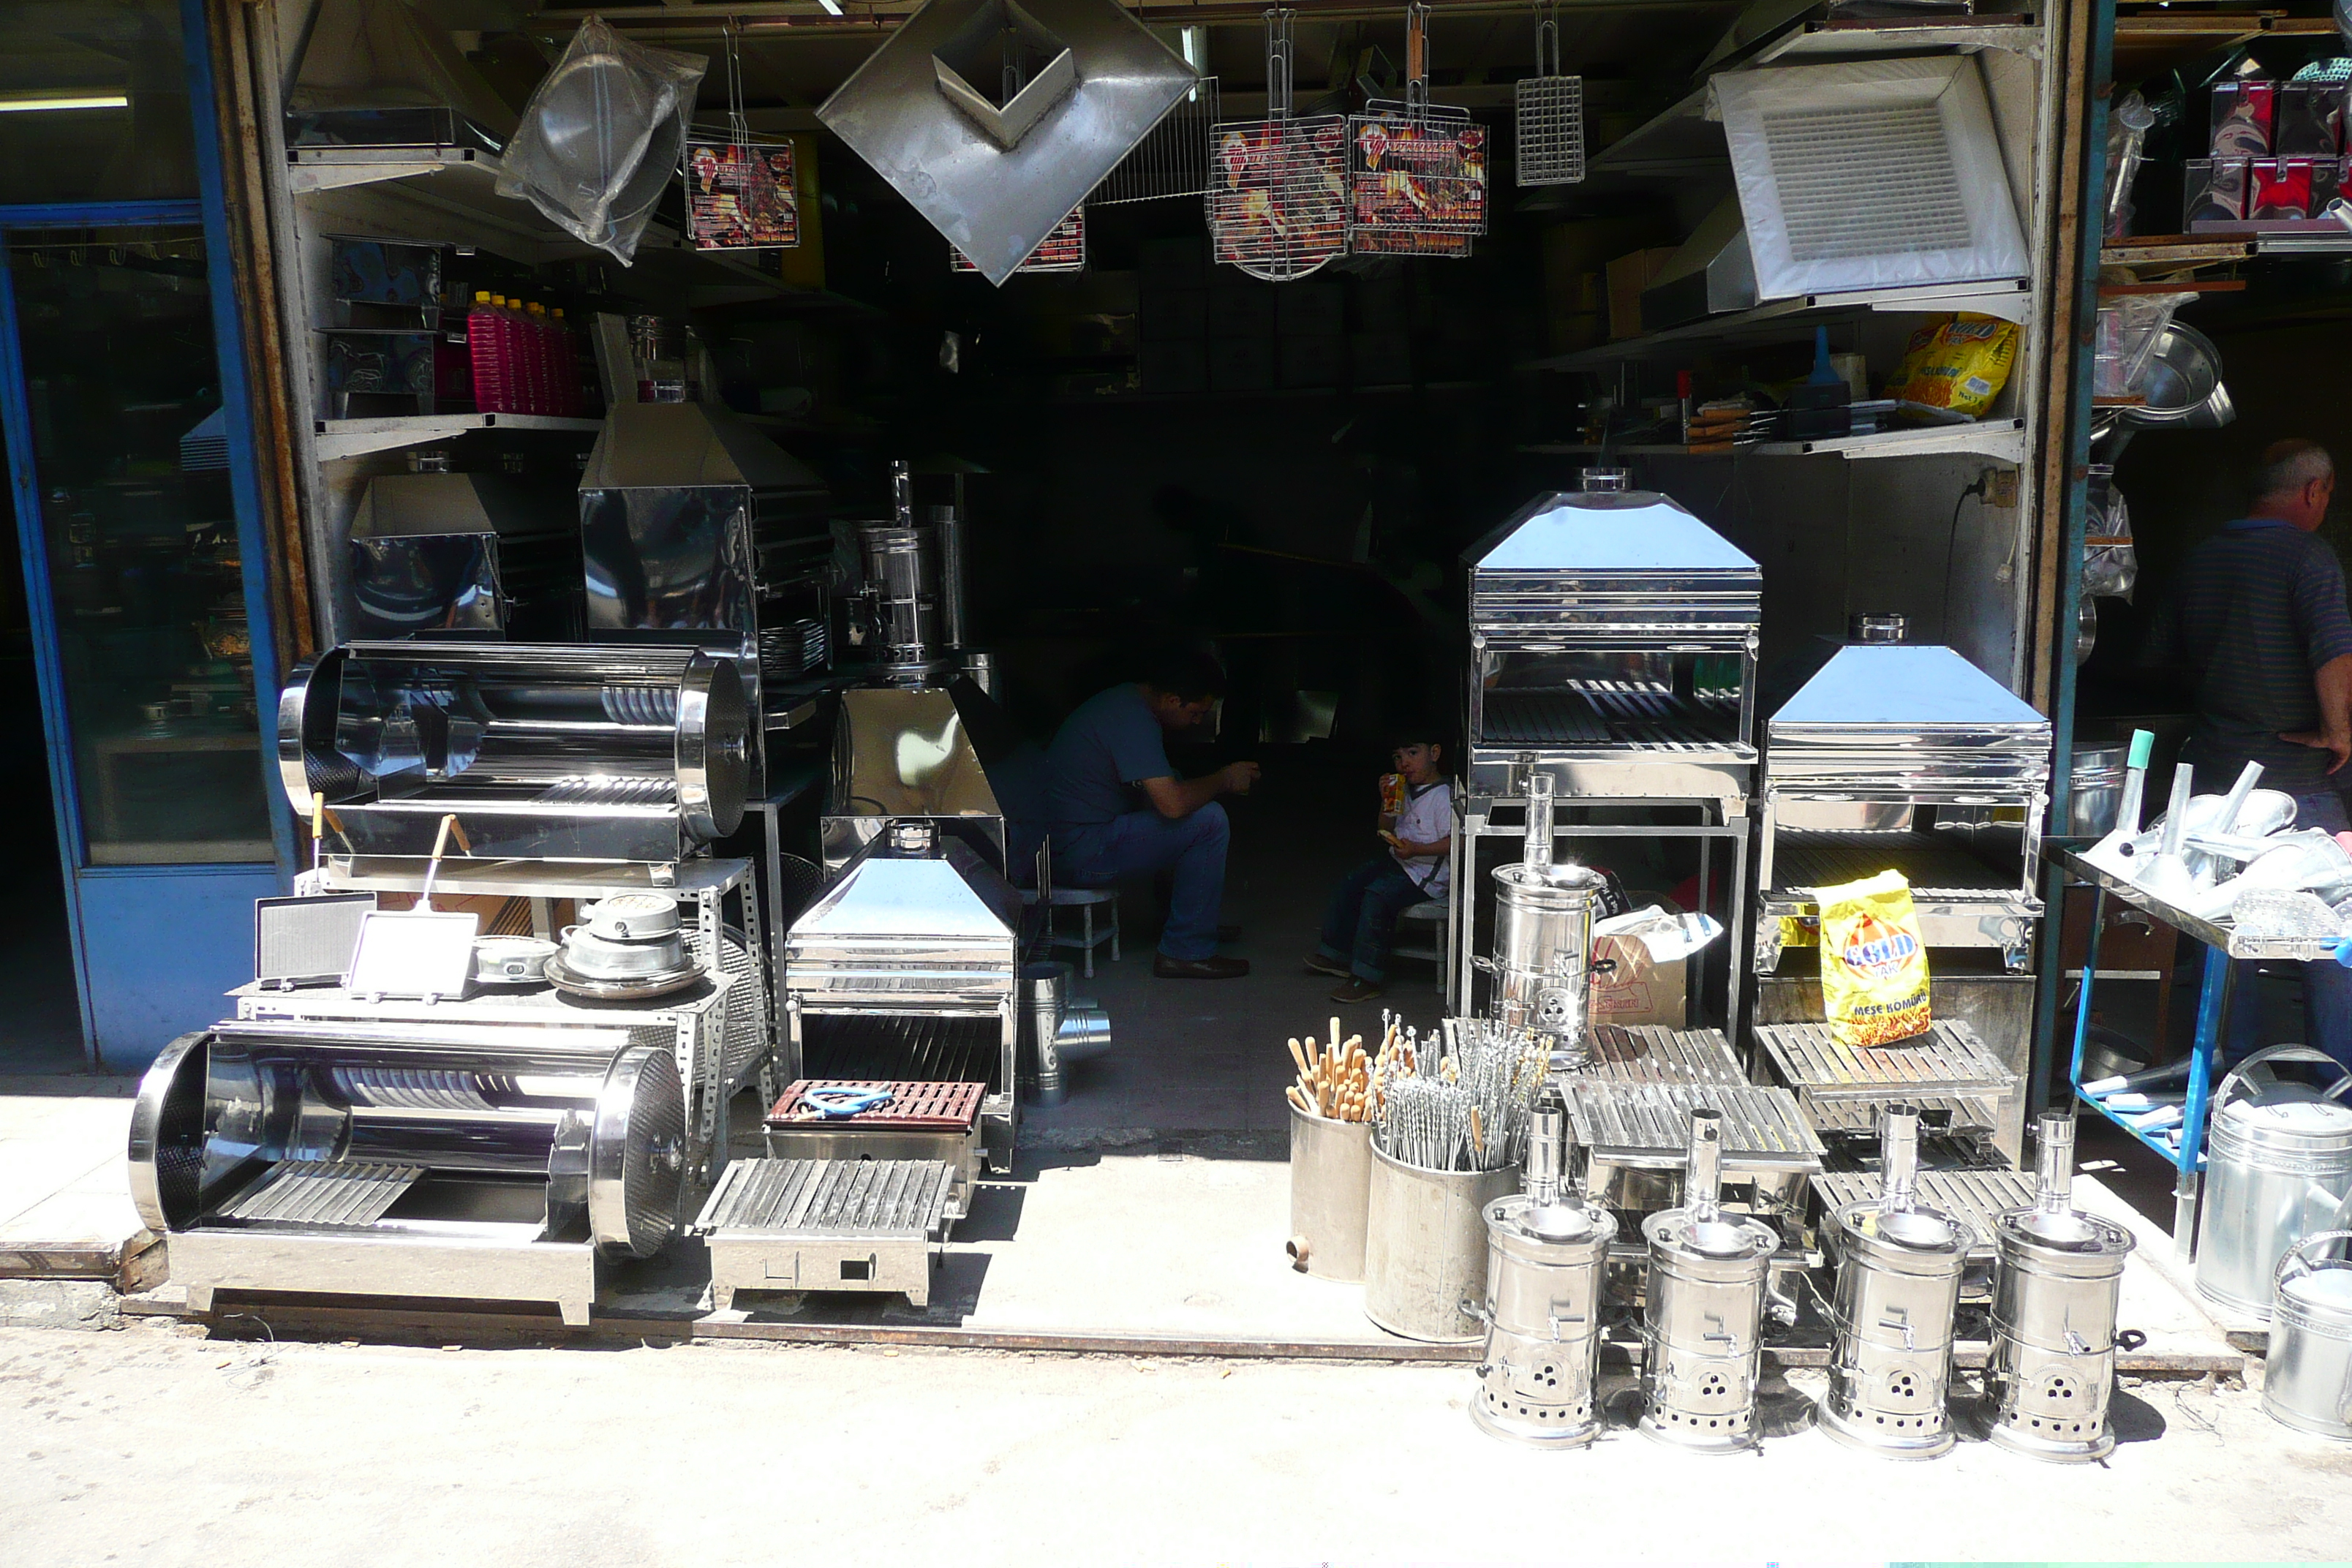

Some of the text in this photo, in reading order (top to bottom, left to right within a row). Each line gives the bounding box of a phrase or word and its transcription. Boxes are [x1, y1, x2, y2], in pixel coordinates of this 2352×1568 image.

[1610, 900, 1618, 914] Net
[1845, 934, 1914, 966] GOLD
[1885, 990, 1927, 1014] KÖMÜRÜ
